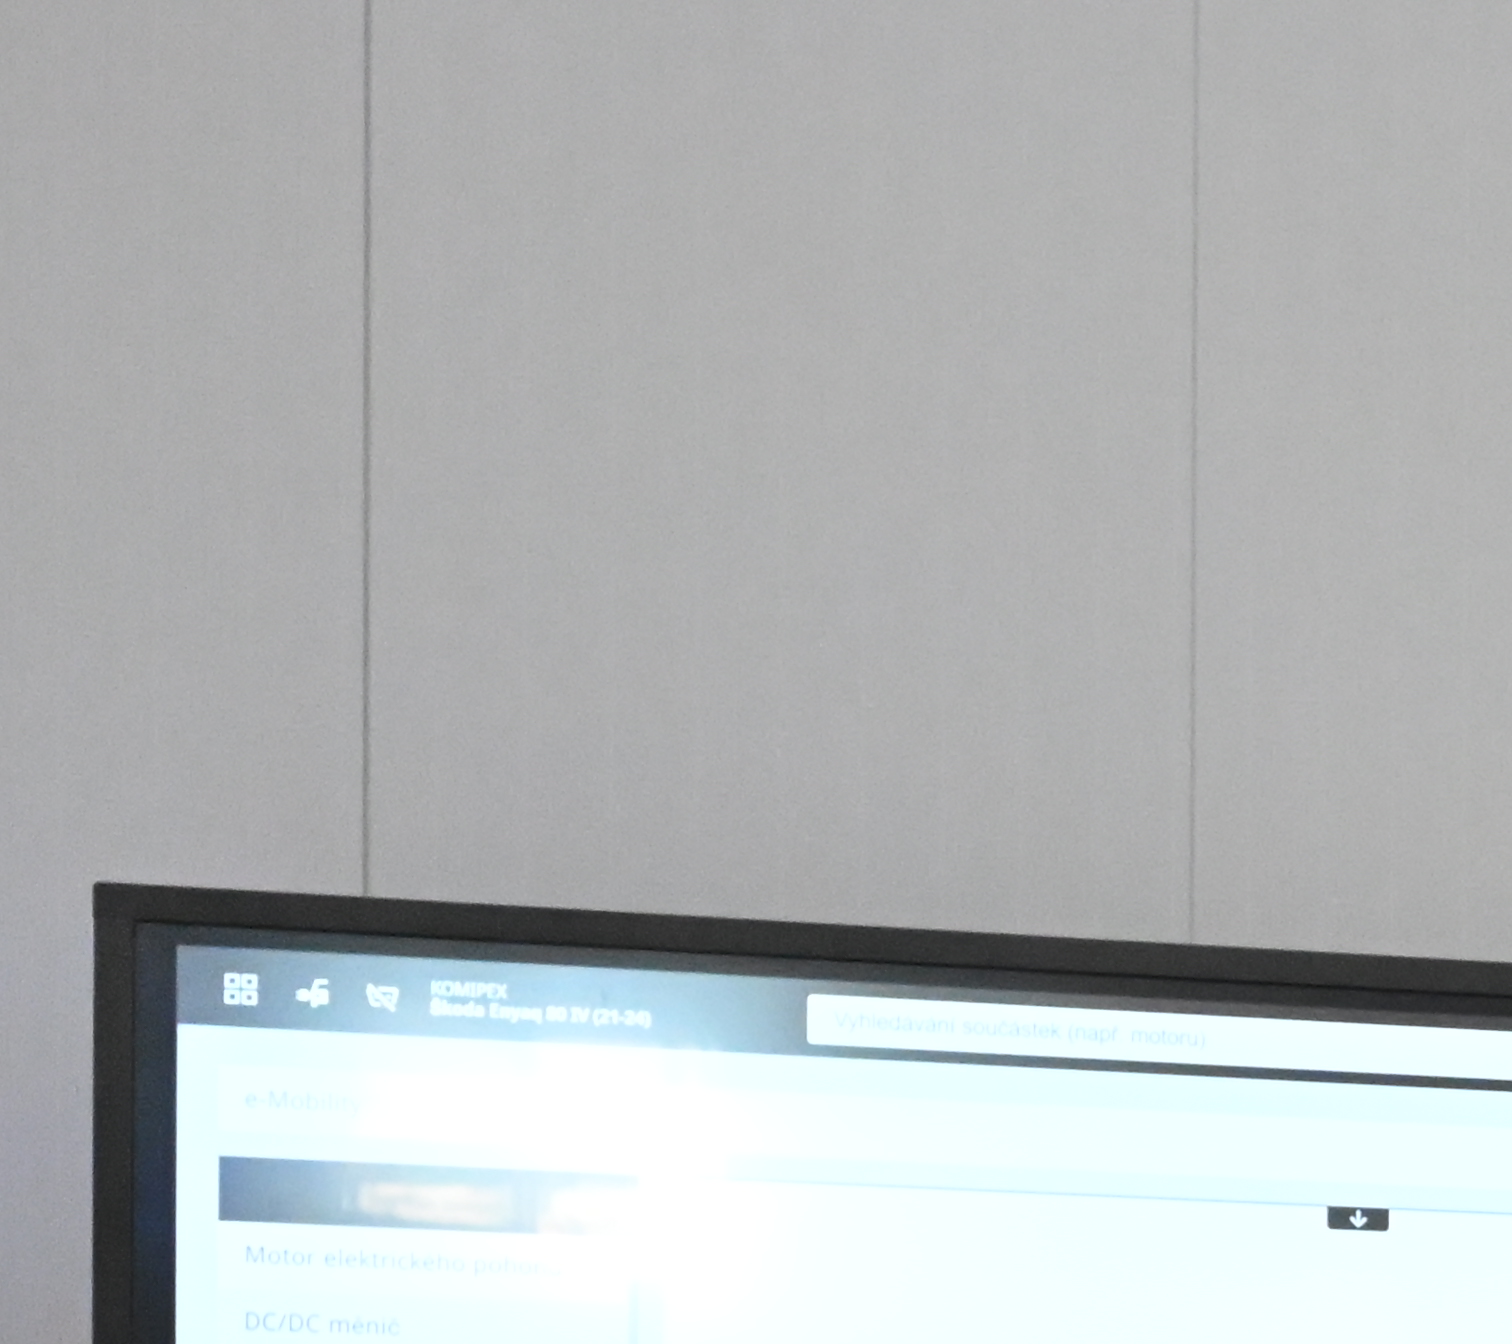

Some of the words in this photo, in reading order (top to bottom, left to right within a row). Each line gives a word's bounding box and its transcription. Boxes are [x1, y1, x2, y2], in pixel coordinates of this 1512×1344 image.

[245, 1244, 314, 1266] Motor
[324, 1249, 466, 1273] elektrického
[245, 1311, 320, 1334] DC/DC
[328, 1311, 401, 1337] měnič
